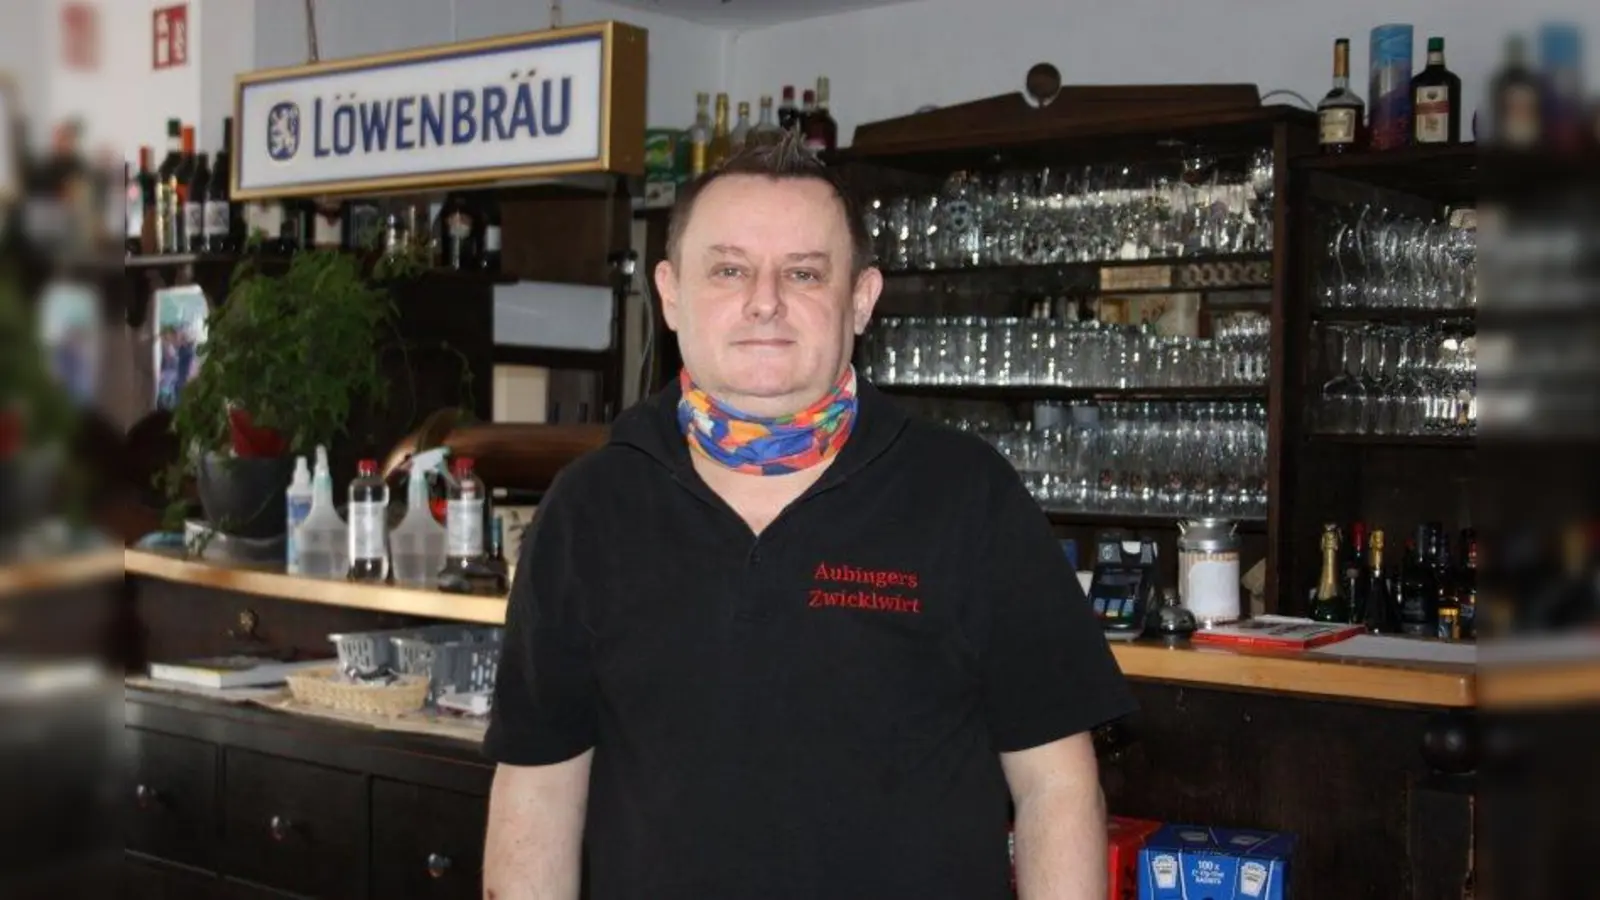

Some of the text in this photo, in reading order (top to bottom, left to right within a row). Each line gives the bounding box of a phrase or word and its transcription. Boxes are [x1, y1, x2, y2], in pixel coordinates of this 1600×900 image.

[314, 69, 571, 157] LÖWENBRÄU
[814, 562, 918, 588] Aubingers
[808, 589, 920, 613] Zwicklwirt
[1198, 860, 1213, 870] 100
